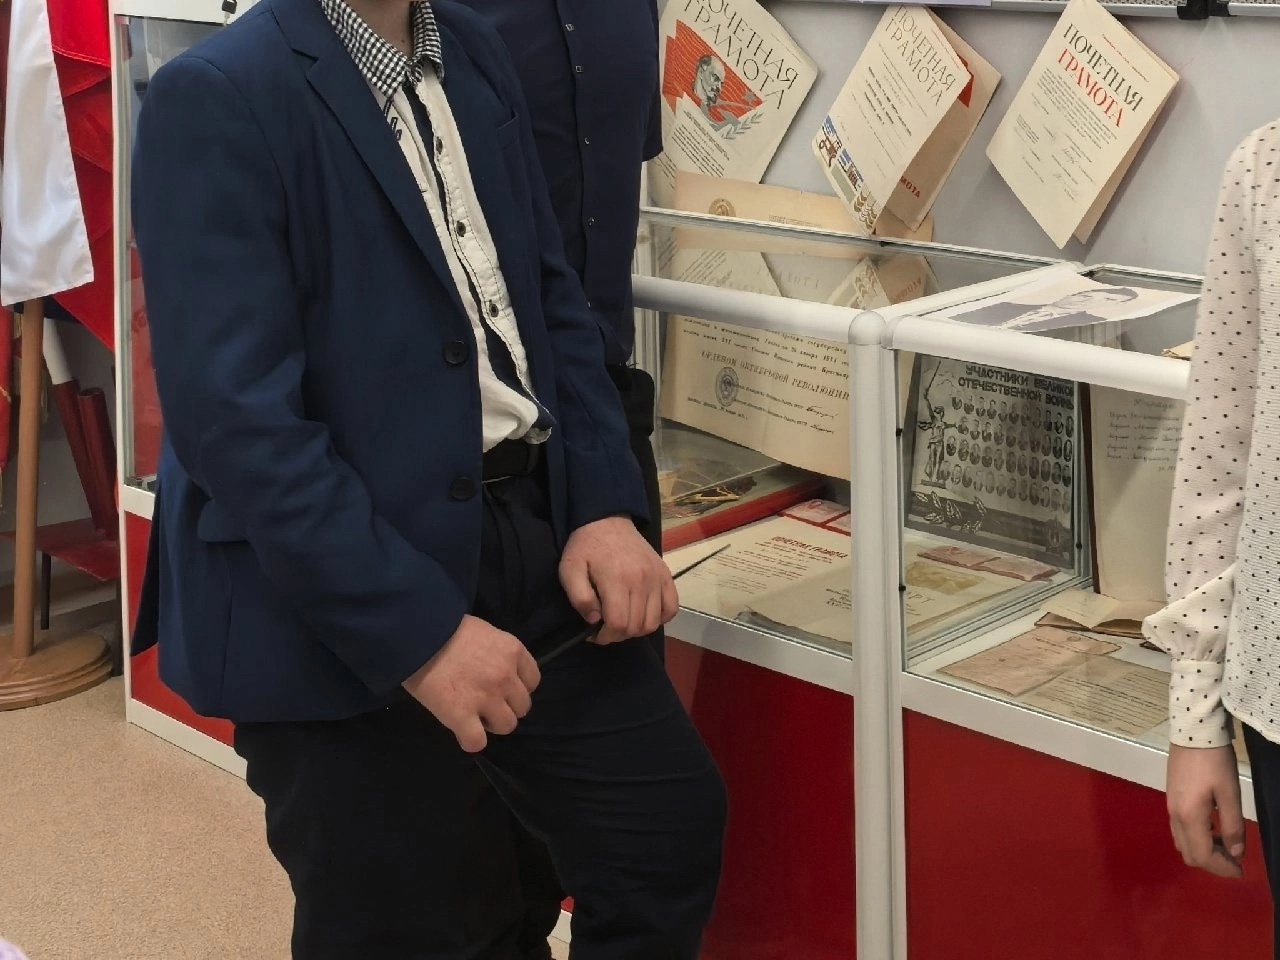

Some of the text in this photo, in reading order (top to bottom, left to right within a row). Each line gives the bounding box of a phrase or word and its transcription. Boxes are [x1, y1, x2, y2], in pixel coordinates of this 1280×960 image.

[885, 18, 943, 107] ГРАМОТА
[894, 4, 956, 92] ПОЧЕТНАЯ
[1058, 48, 1123, 128] ГРАМОТА
[1063, 23, 1144, 112] ПОЧЕТНАЯ
[958, 376, 1041, 402] ОТЕЧЕСТВЕННОЙ
[965, 365, 1029, 387] УЧАСТНИКИ
